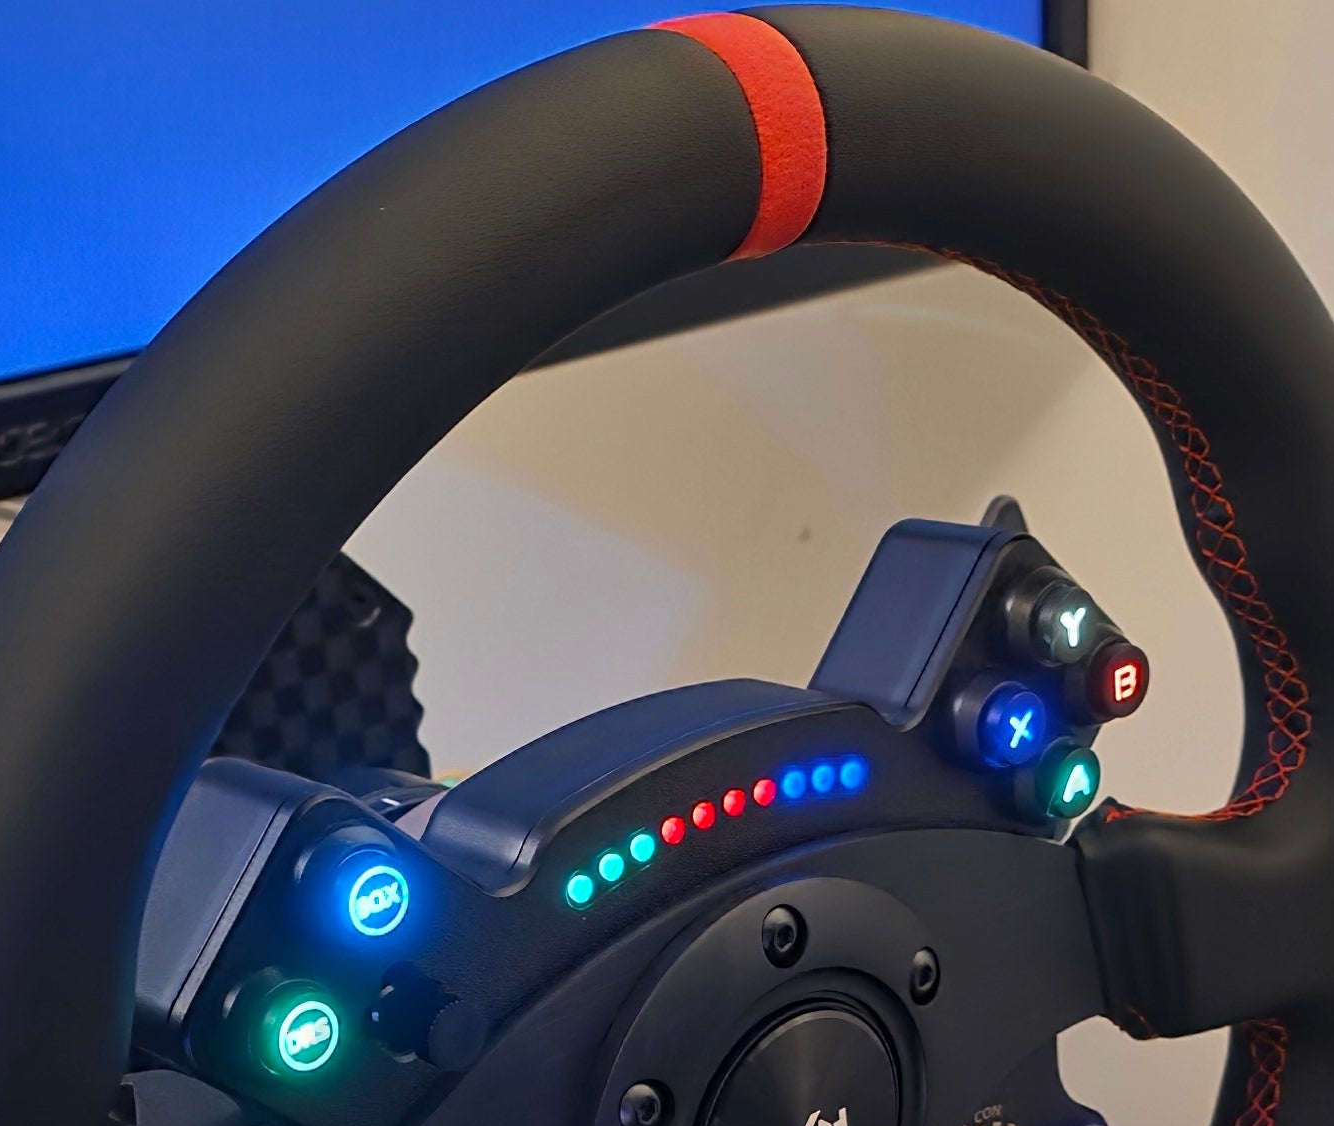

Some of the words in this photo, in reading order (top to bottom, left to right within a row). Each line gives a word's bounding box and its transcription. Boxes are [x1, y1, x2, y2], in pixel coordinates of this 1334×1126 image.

[1059, 607, 1086, 647] Y
[1113, 664, 1137, 701] B
[1008, 710, 1033, 748] X
[1062, 764, 1091, 803] A
[356, 881, 401, 921] BOX
